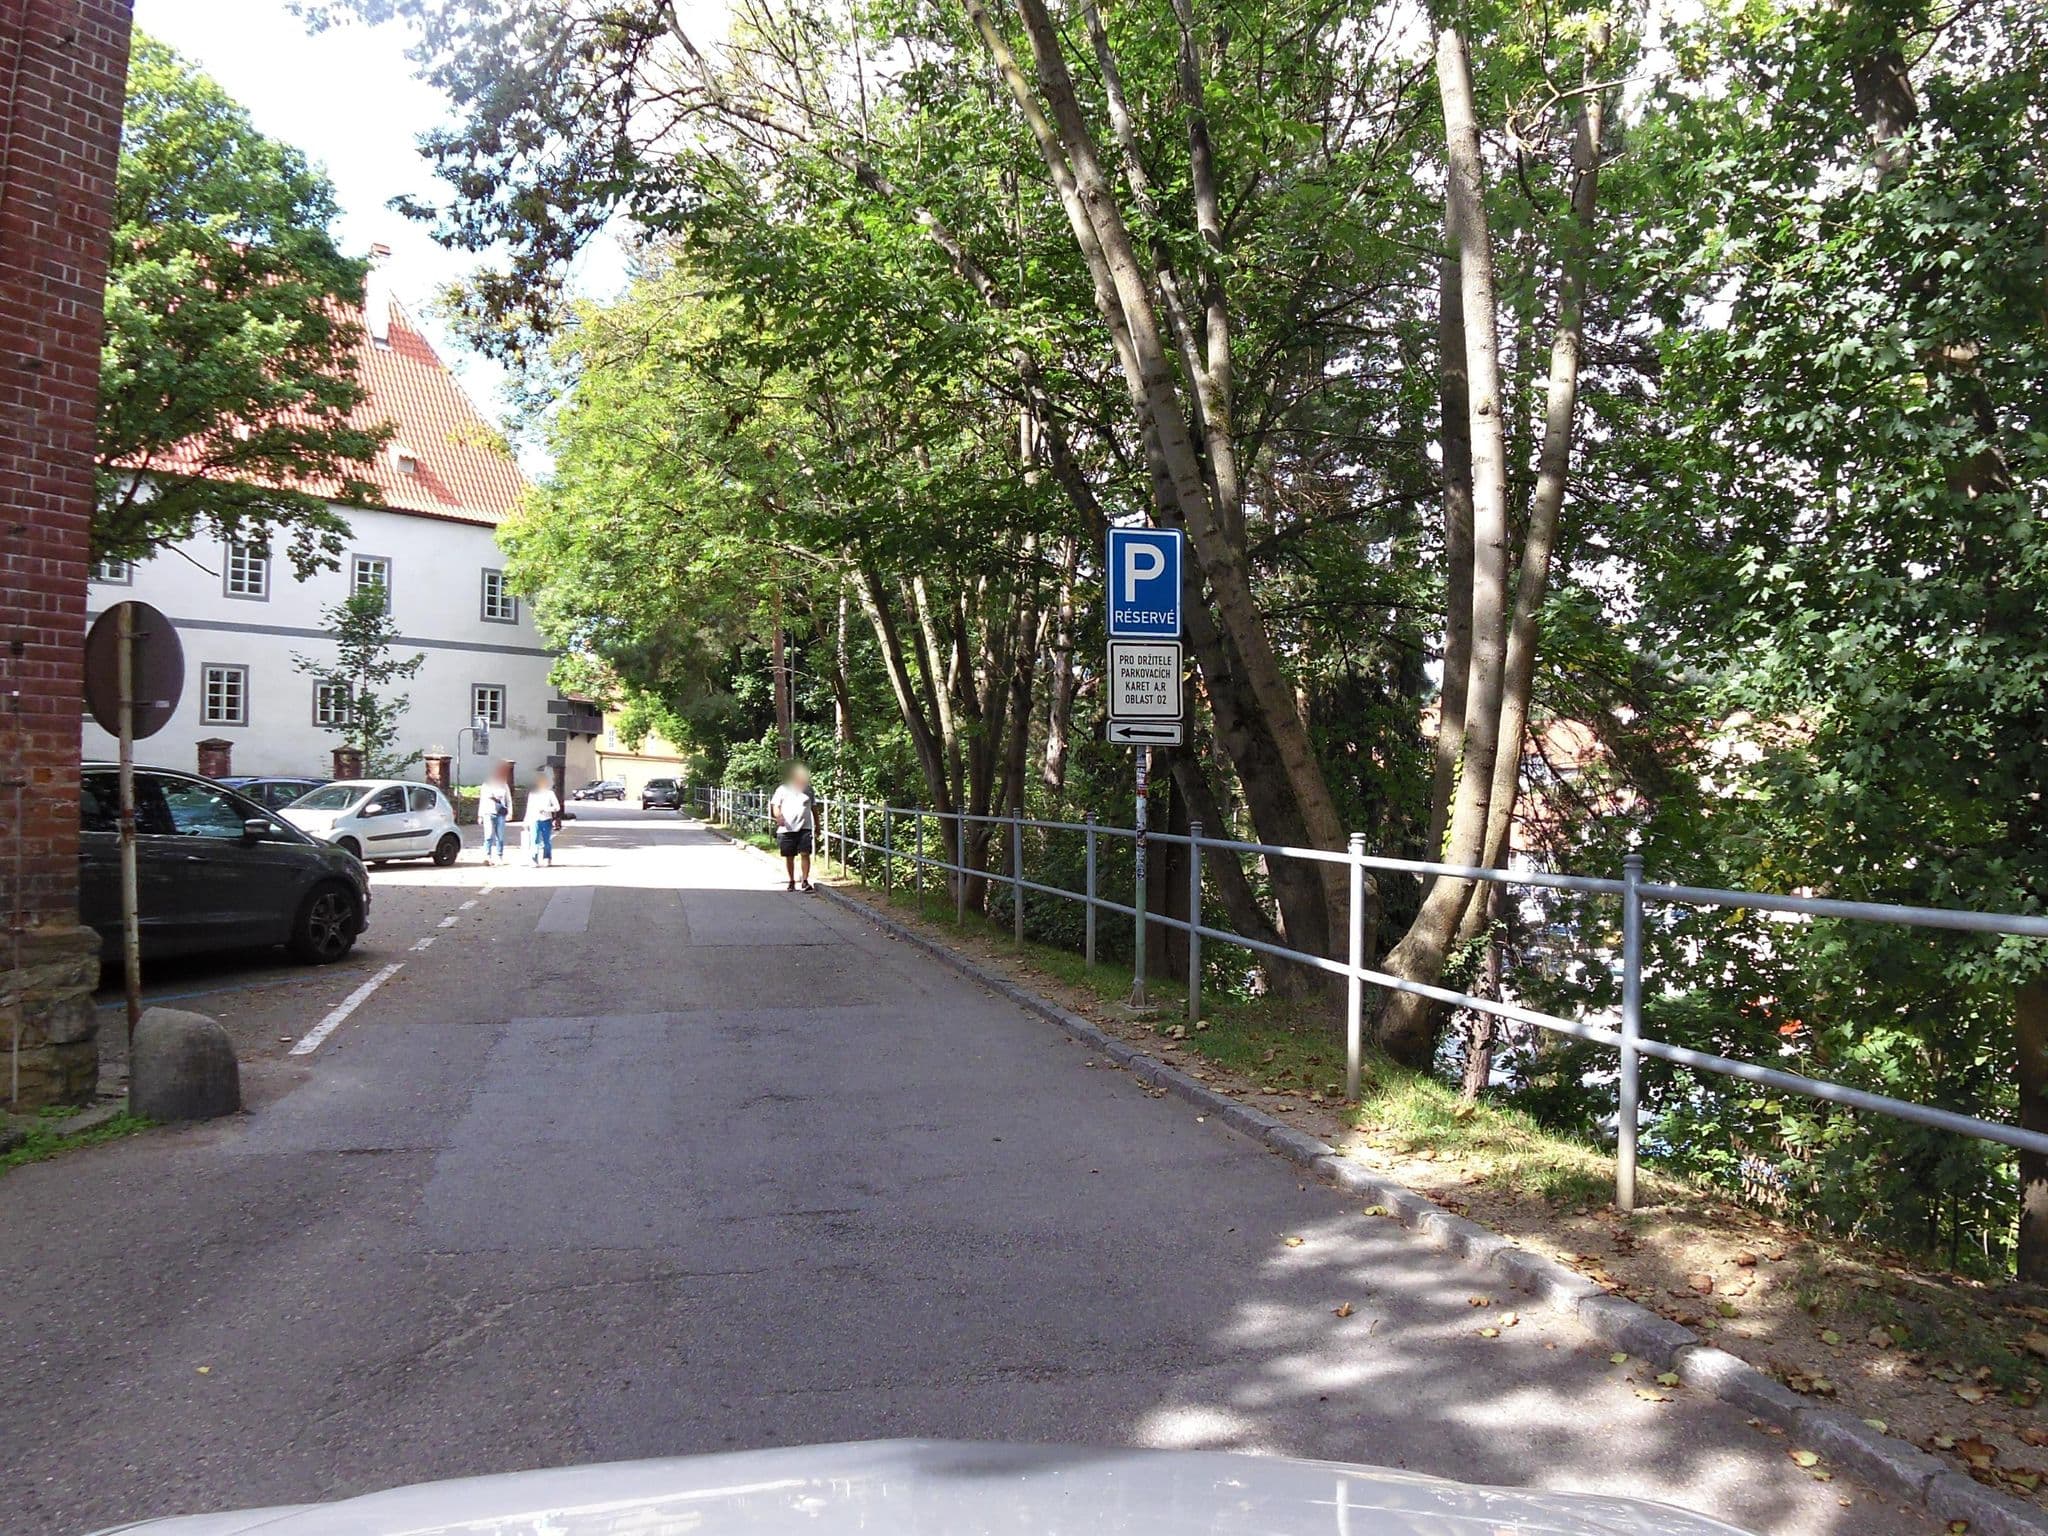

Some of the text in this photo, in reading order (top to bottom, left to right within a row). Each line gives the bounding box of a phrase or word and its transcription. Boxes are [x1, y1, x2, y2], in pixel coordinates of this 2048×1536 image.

[1125, 542, 1165, 602] P
[1115, 608, 1175, 625] RÉSERVÉ
[1119, 654, 1172, 666] PRO DRŽITELE
[1121, 667, 1171, 679] PARKOVACÍCH
[1125, 681, 1150, 691] KARET
[1125, 694, 1167, 705] OBLAST 02
